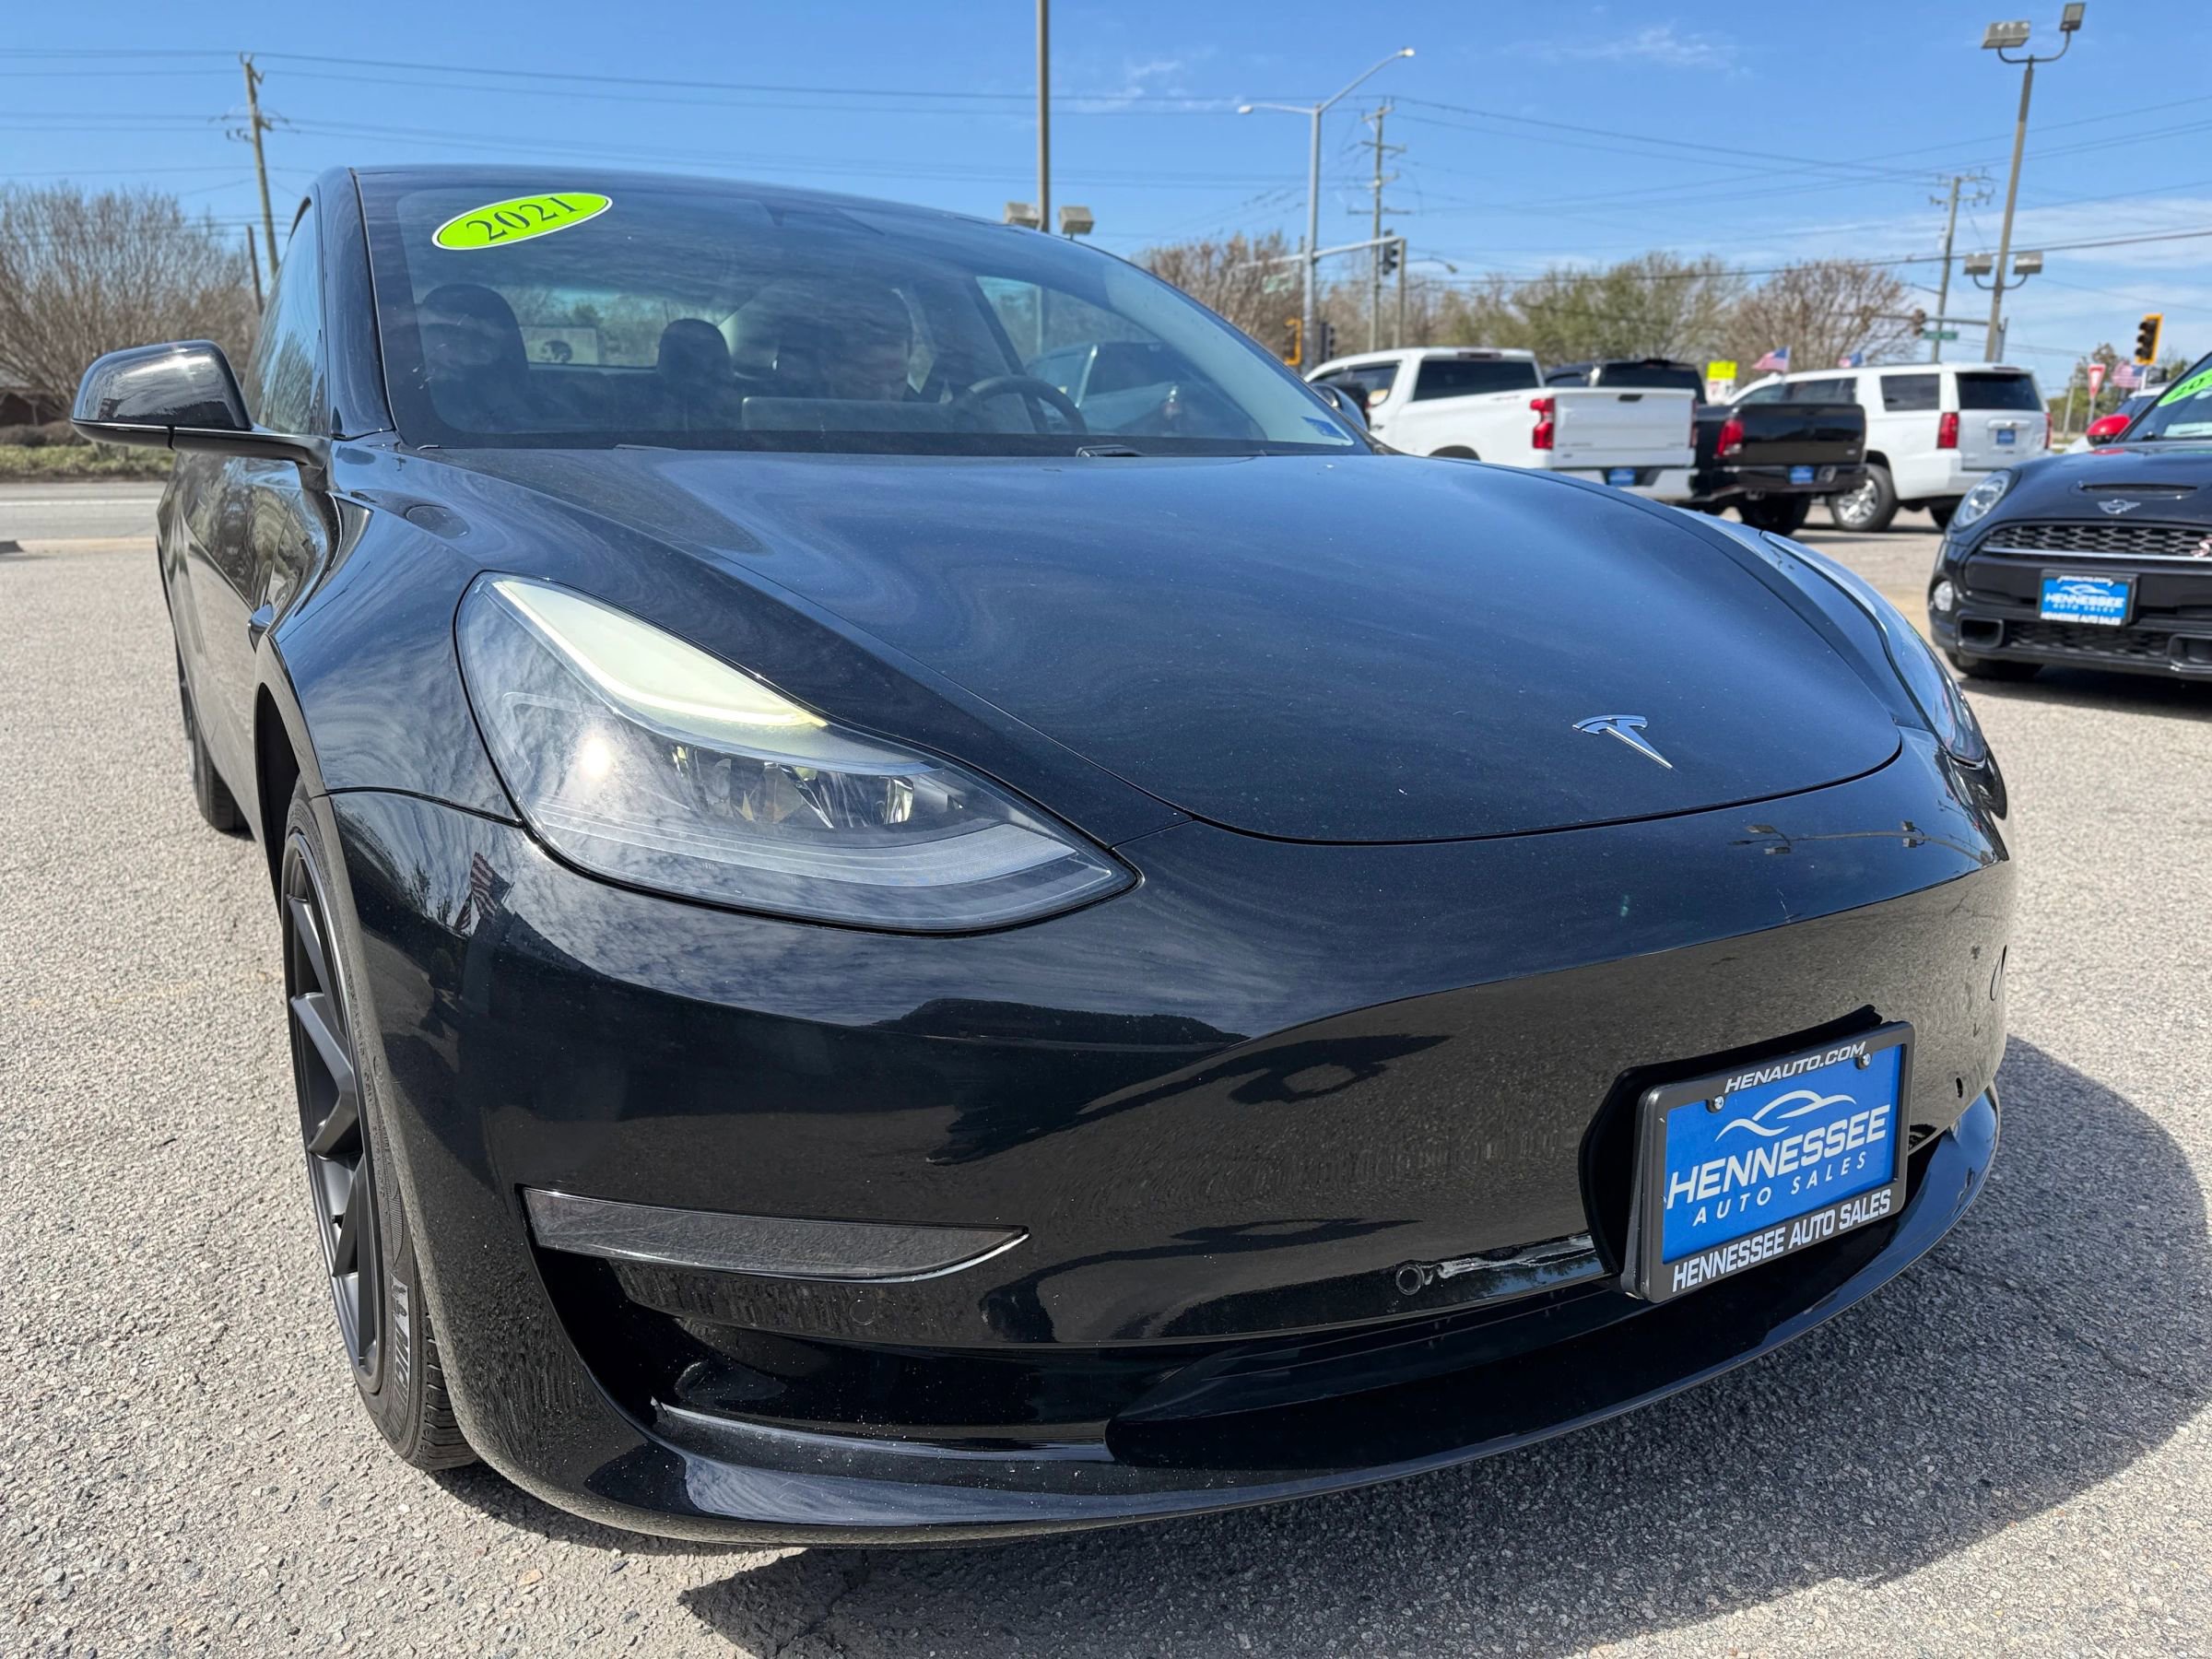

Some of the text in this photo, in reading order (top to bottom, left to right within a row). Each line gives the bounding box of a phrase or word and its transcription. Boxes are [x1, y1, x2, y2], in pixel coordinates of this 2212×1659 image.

[466, 196, 582, 241] 2021
[2044, 593, 2124, 608] HENNESSEE
[1724, 1041, 1865, 1093] HENAUTO.COM
[1666, 1104, 1890, 1209] HENNESSEE
[1692, 1151, 1866, 1227] AUTO SALES
[1673, 1189, 1890, 1292] HENNESSEE AUTO SALES
